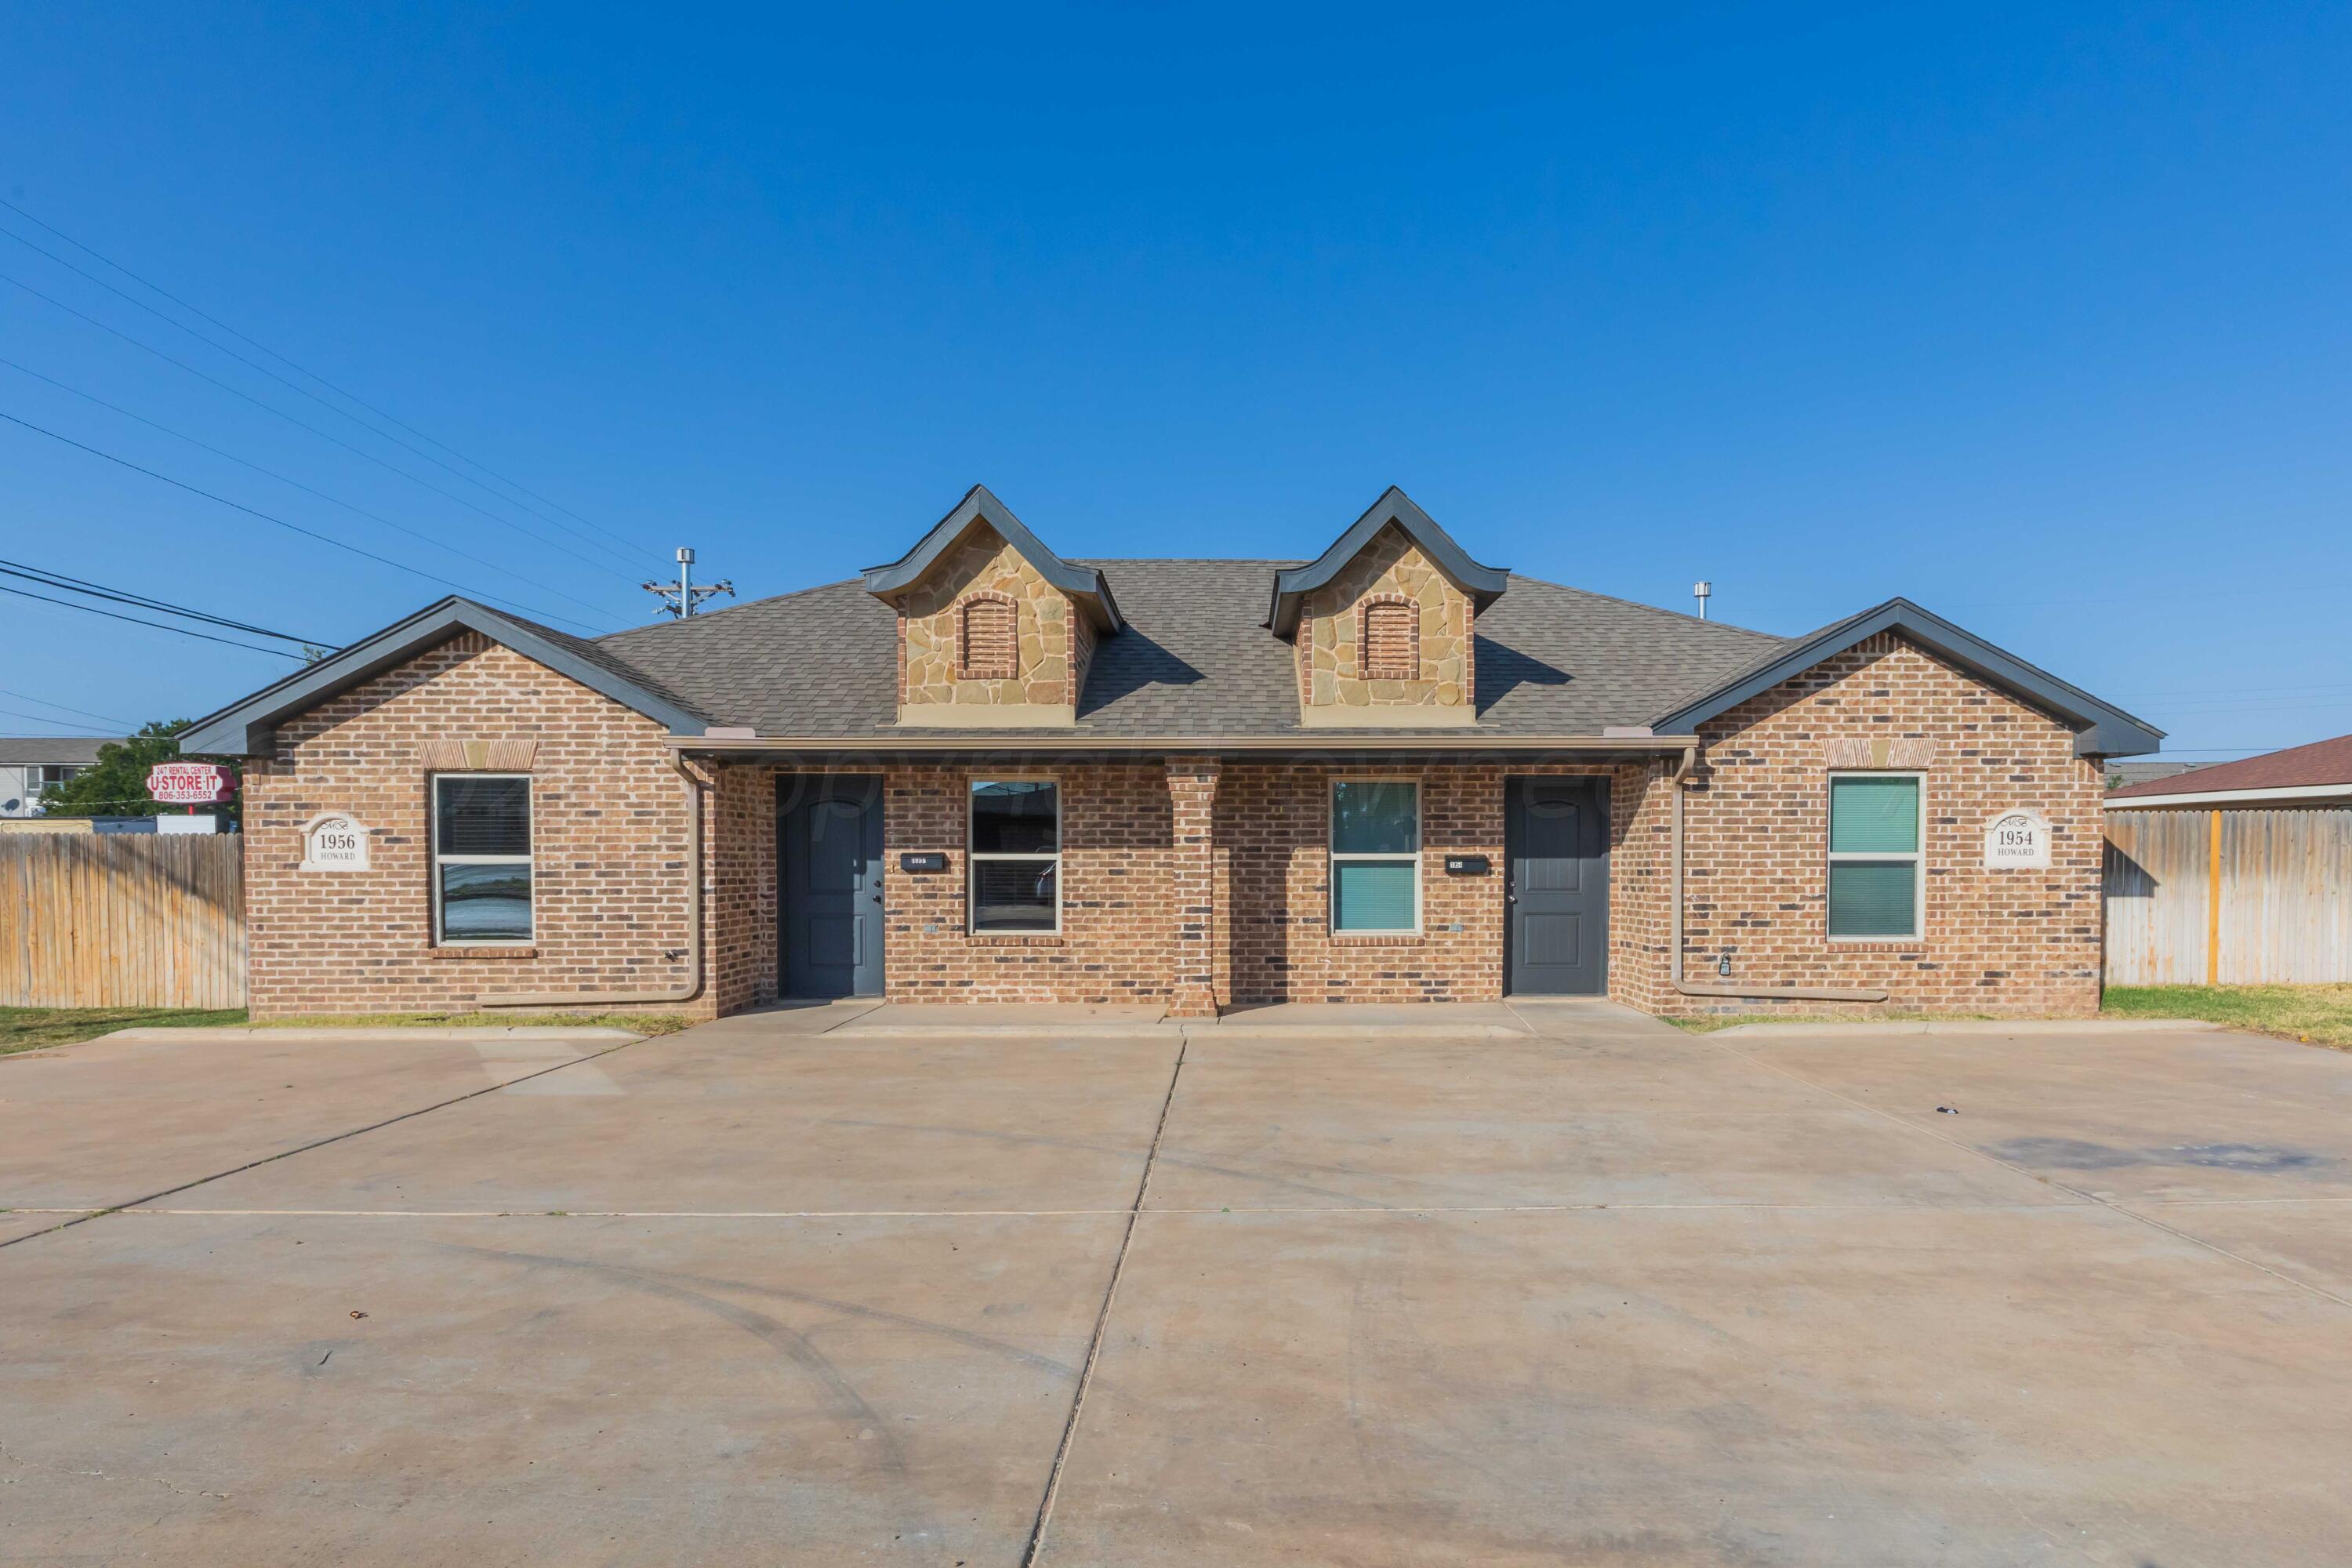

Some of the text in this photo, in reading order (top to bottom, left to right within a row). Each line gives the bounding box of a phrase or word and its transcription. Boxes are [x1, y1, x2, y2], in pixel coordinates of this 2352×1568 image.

[169, 766, 189, 775] RENTAL
[191, 766, 212, 775] CENTER
[158, 791, 212, 800] 806-353-6552
[321, 834, 355, 850] 1956
[1999, 830, 2034, 846] 1954
[321, 852, 356, 861] HOWARD
[1997, 848, 2035, 857] HOWARD
